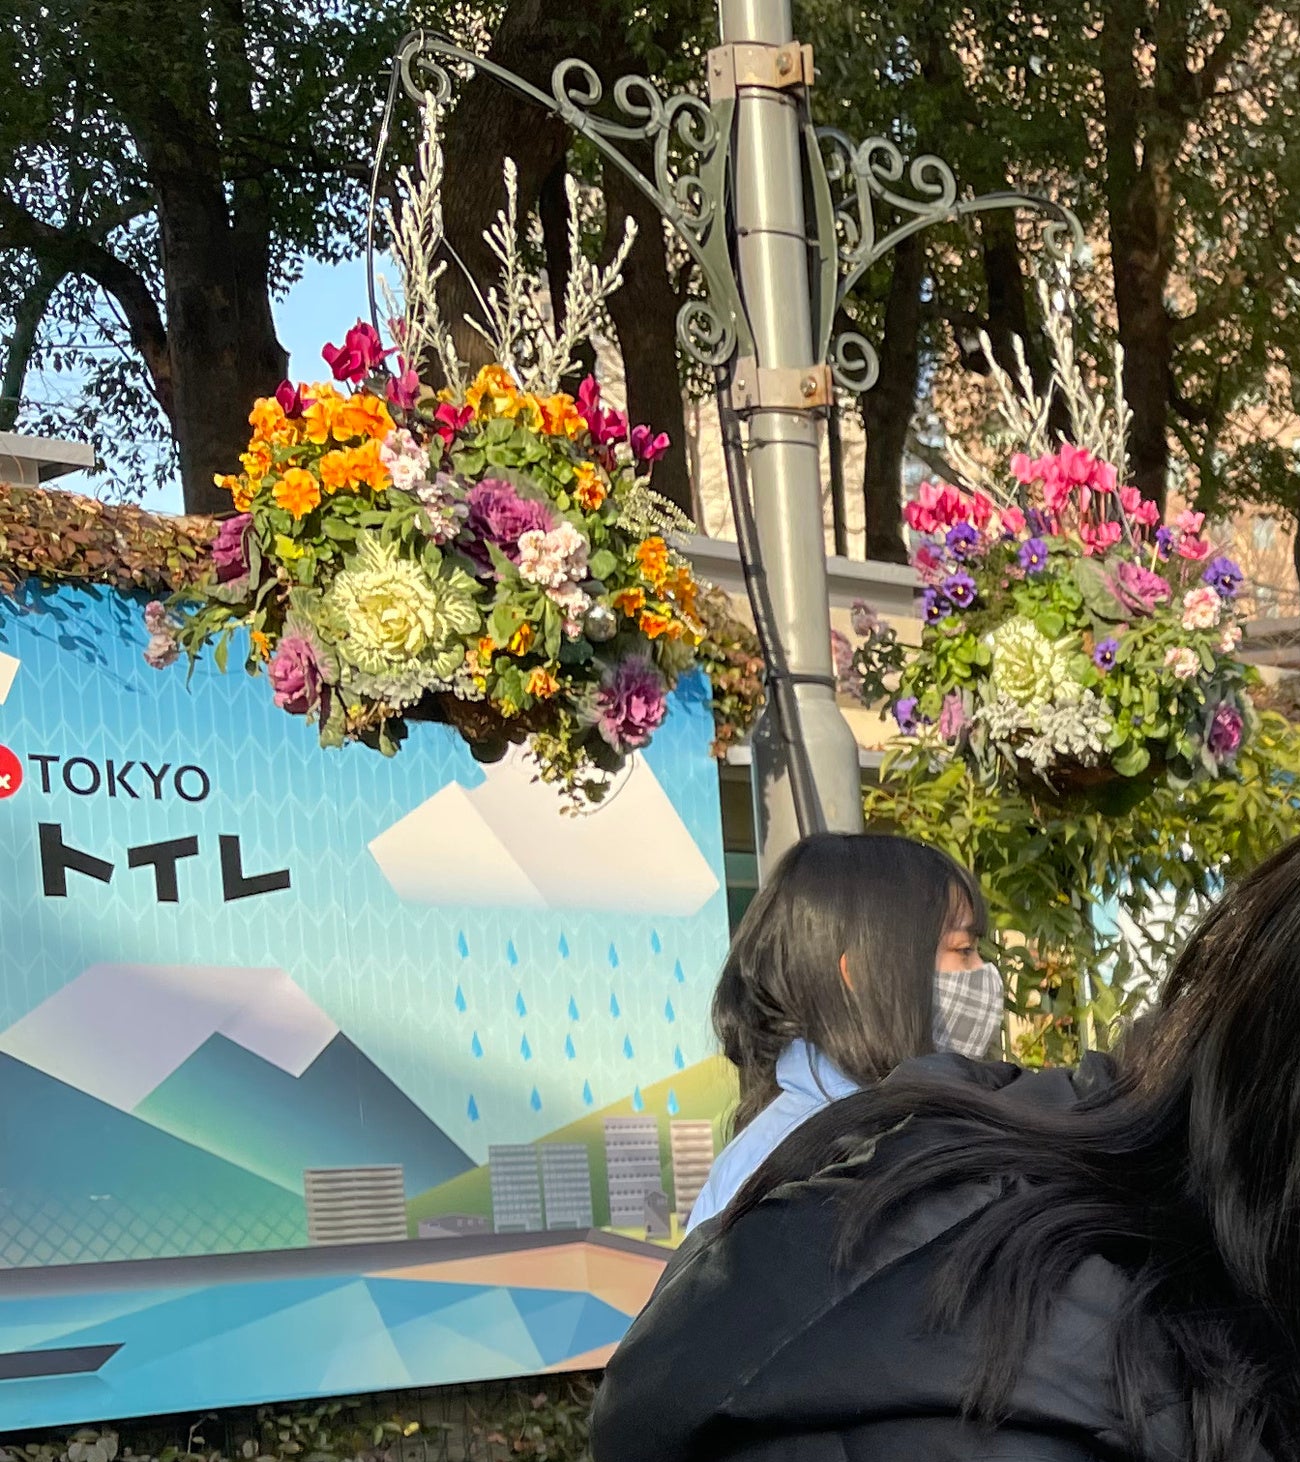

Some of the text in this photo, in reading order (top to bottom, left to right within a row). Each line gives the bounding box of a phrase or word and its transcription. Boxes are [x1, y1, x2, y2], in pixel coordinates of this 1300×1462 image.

[27, 752, 211, 803] TOKYO
[37, 821, 292, 903] トイレ
